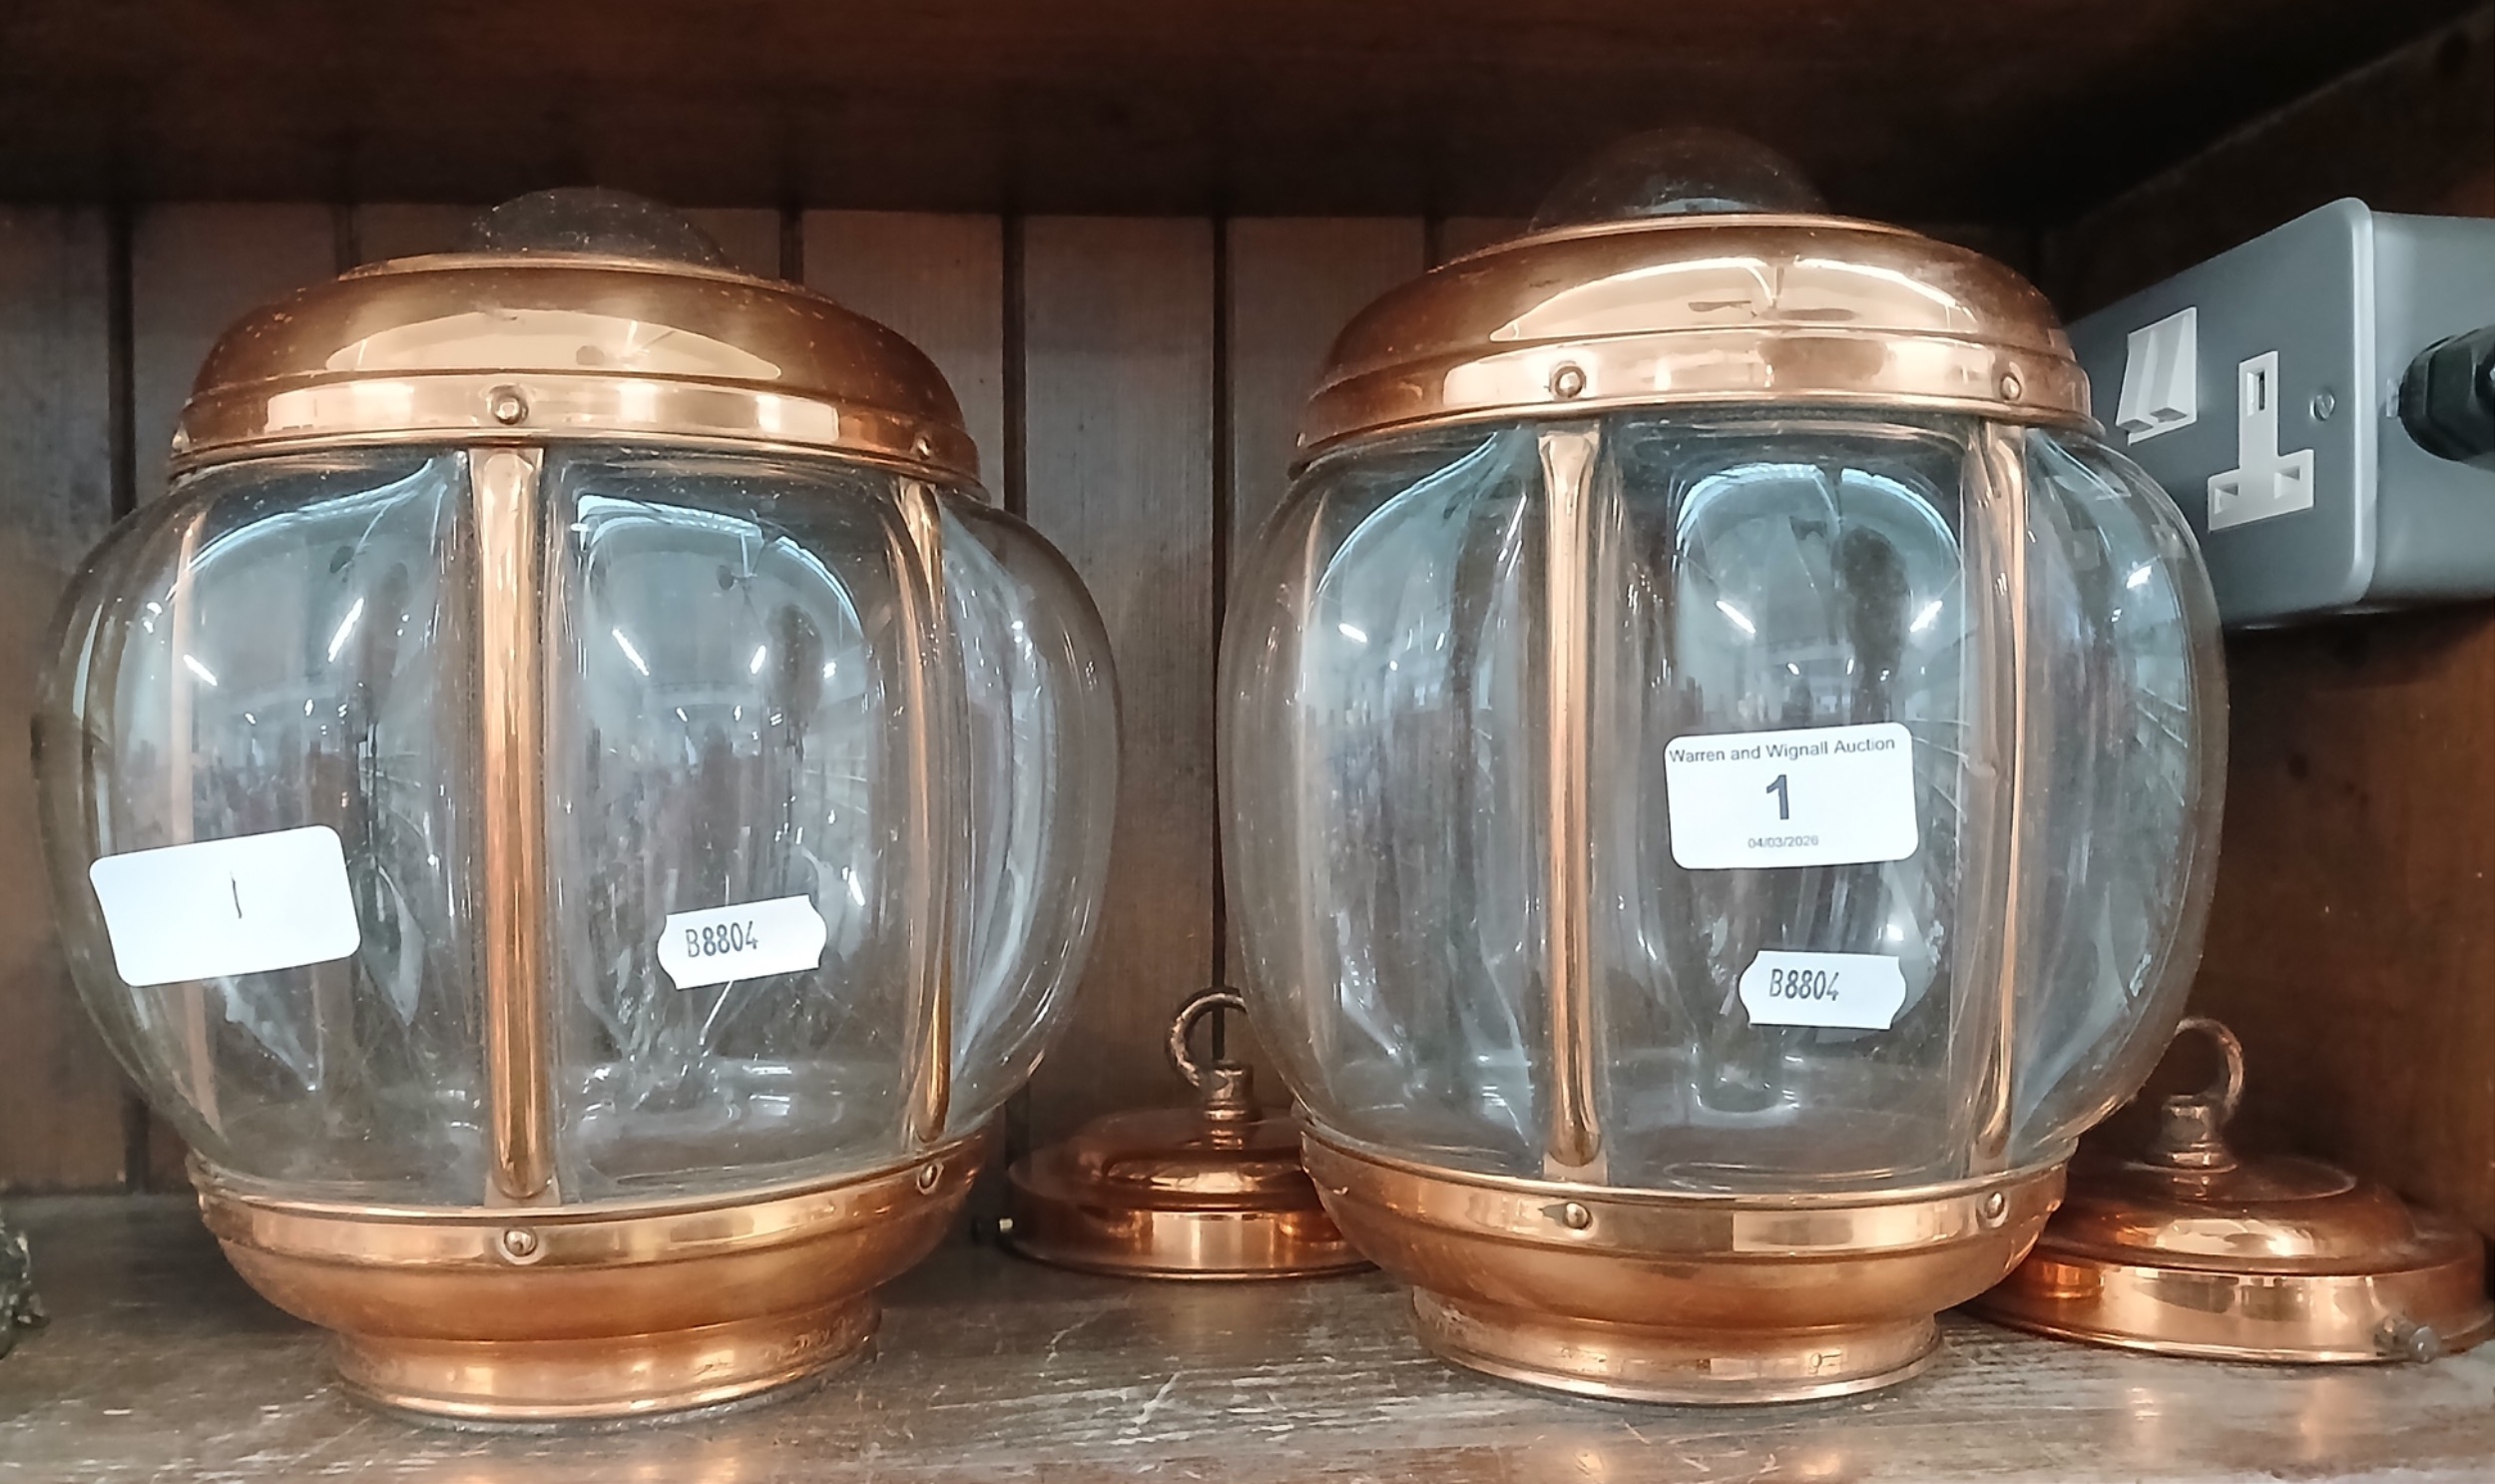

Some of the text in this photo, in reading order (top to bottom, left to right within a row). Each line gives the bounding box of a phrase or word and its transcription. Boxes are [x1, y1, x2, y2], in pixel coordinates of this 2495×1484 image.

[1669, 738, 1896, 762] Warren and Wignall Auction
[1765, 773, 1789, 820] 1
[1747, 835, 1819, 848] 04/03/2026
[685, 920, 759, 958] B8804
[1768, 967, 1840, 1002] B8804
